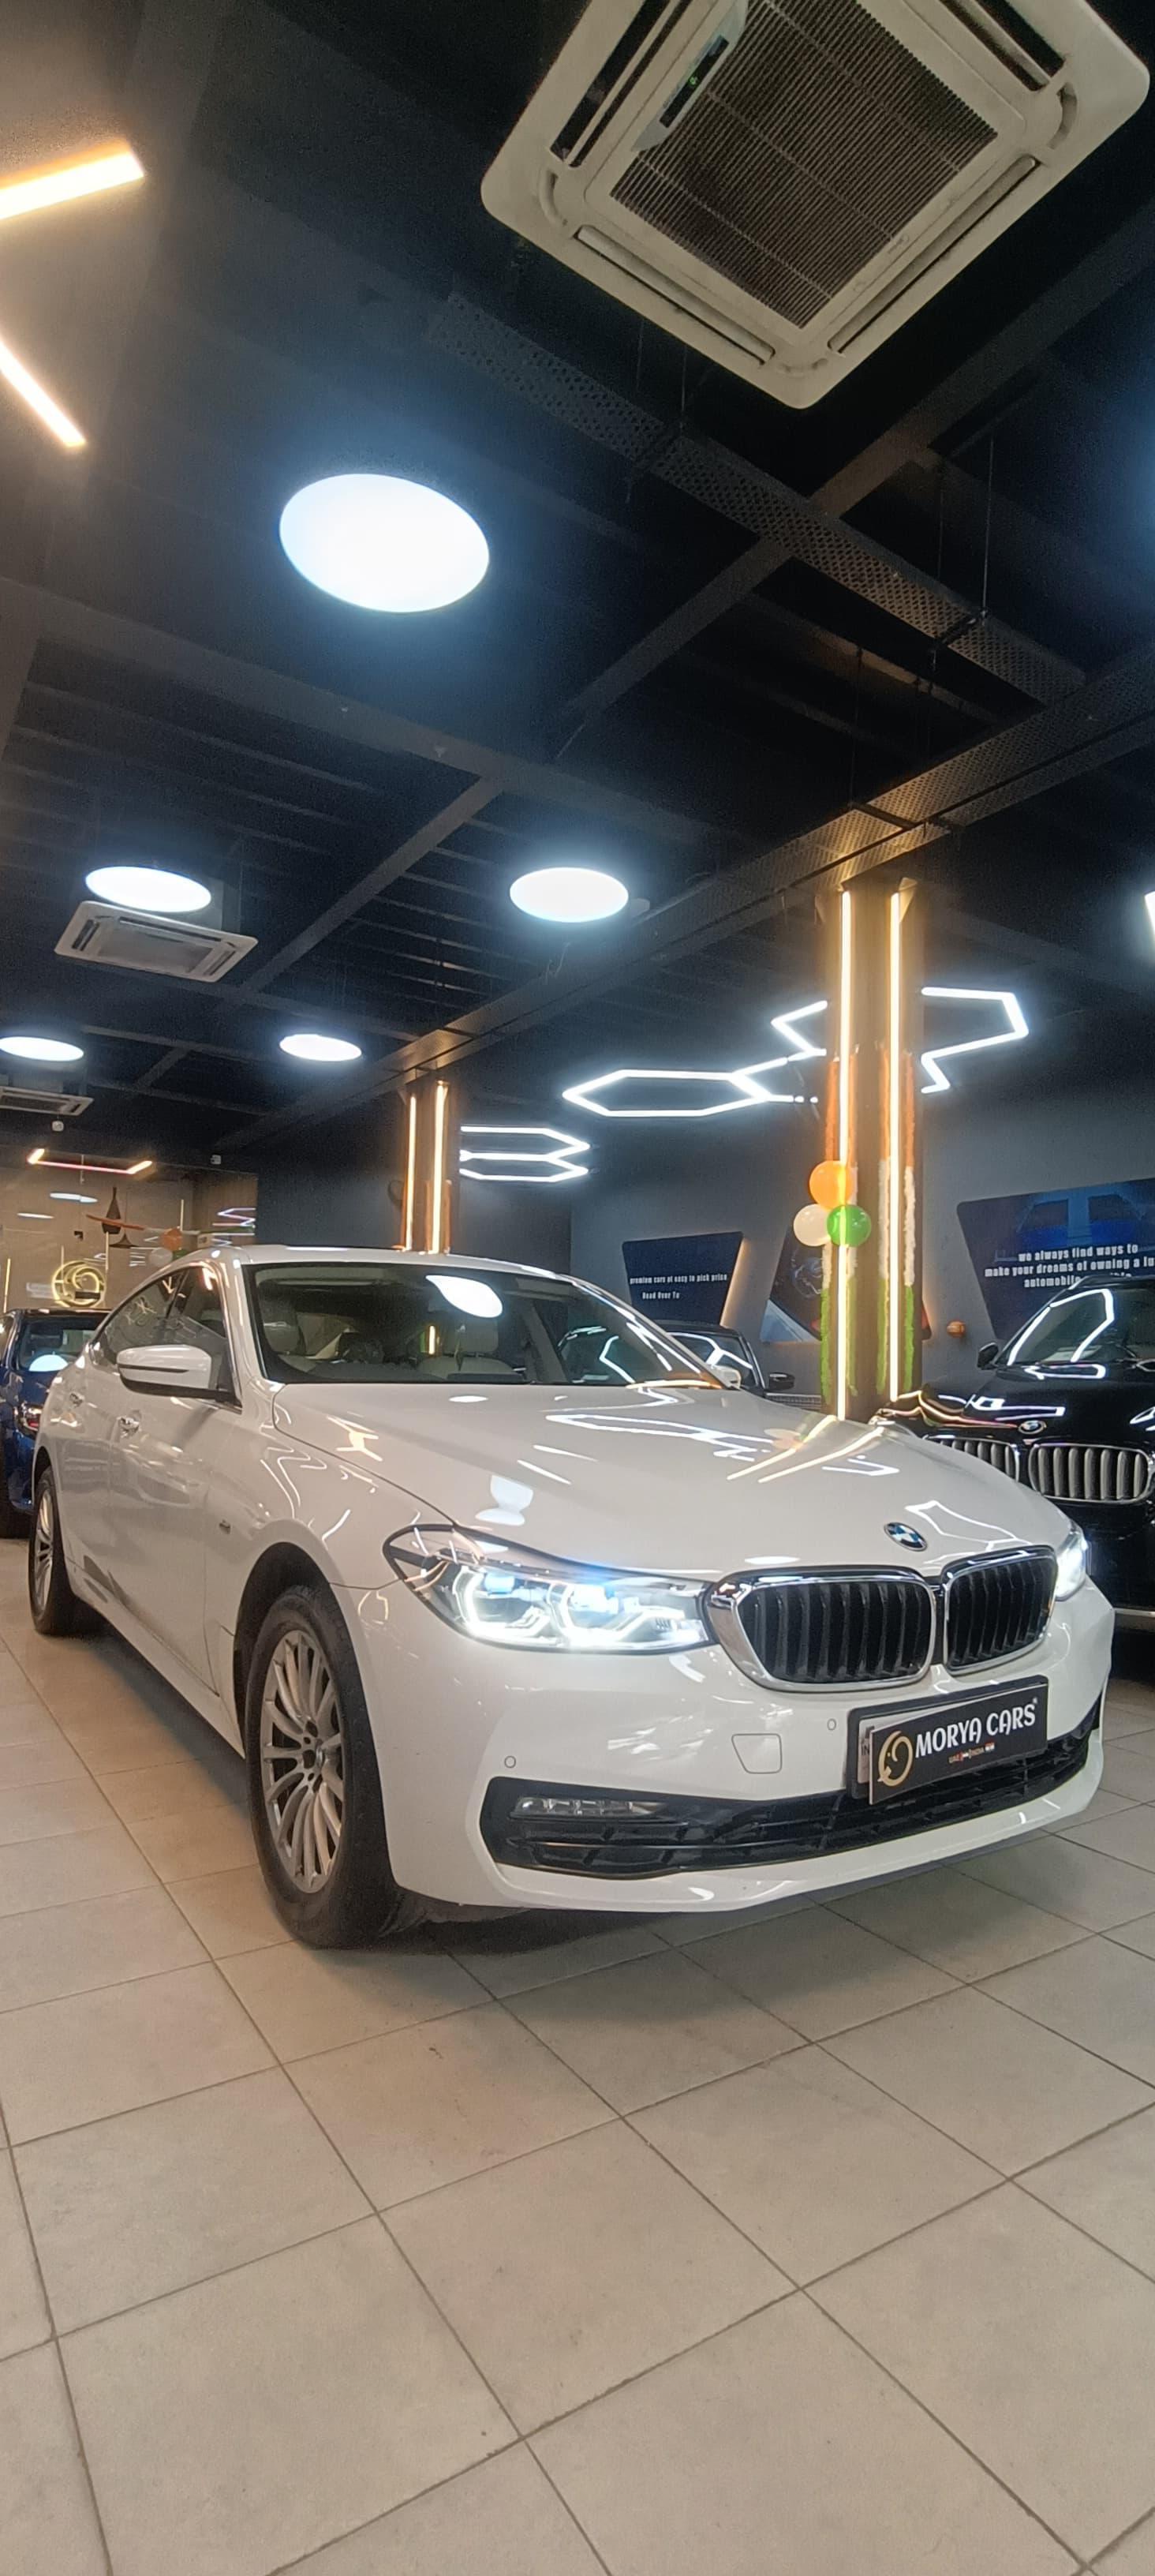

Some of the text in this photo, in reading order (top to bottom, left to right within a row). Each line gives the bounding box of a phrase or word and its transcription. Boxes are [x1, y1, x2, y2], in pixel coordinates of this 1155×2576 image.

[1019, 1243, 1138, 1262] we always find ways to
[985, 1266, 1010, 1277] make
[1012, 1265, 1034, 1276] your
[1036, 1263, 1074, 1274] dreams
[1077, 1260, 1087, 1271] of
[1090, 1258, 1130, 1271] owning
[1133, 1258, 1140, 1268] a
[915, 1703, 1036, 1758] MORYA CARS
